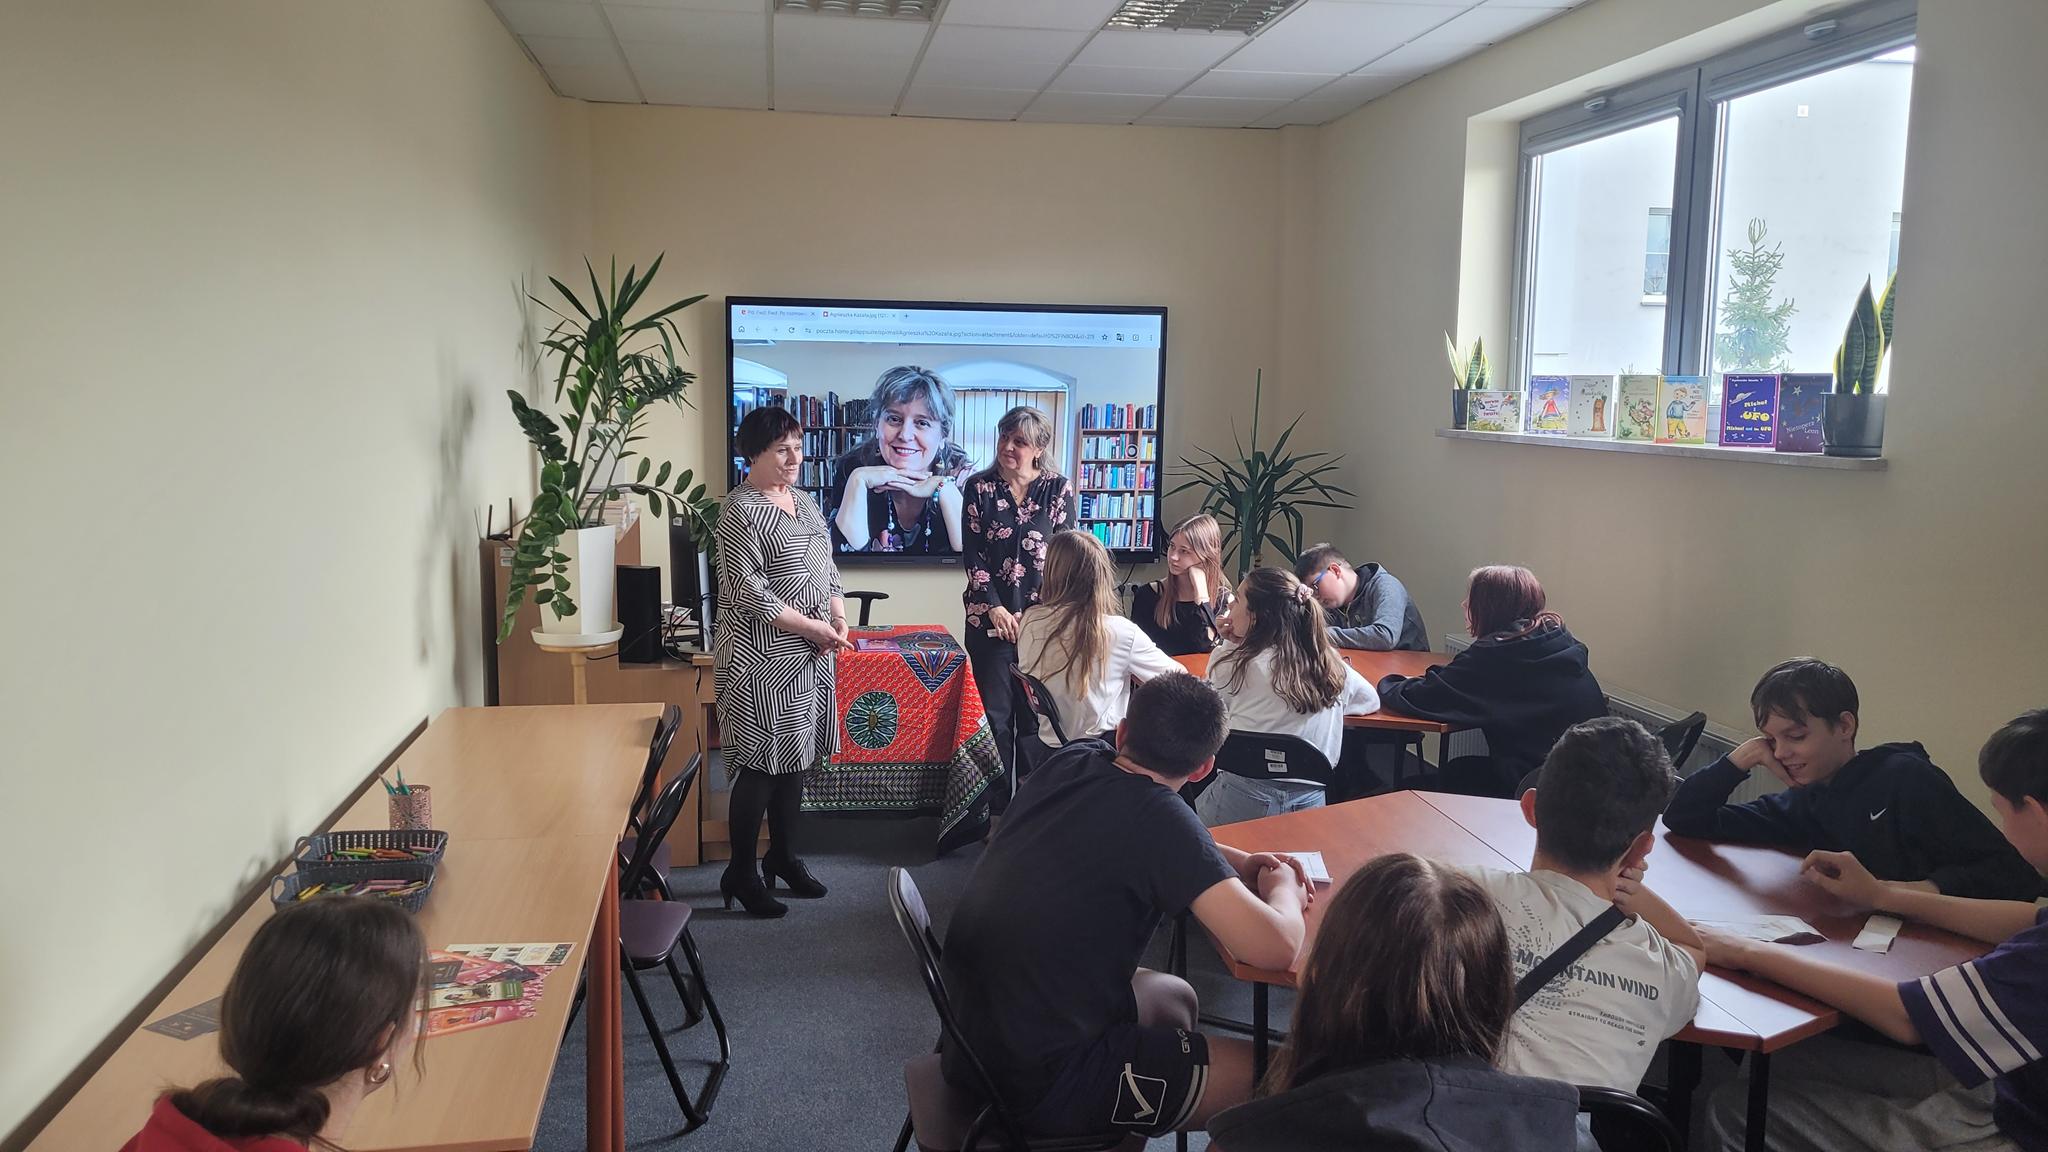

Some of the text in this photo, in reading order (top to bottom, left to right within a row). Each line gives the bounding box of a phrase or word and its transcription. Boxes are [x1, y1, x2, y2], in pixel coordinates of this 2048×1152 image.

[1743, 411, 1770, 422] UFO
[1516, 949, 1660, 1001] MONTAIN WIND
[1568, 1010, 1598, 1022] STRAIGHT
